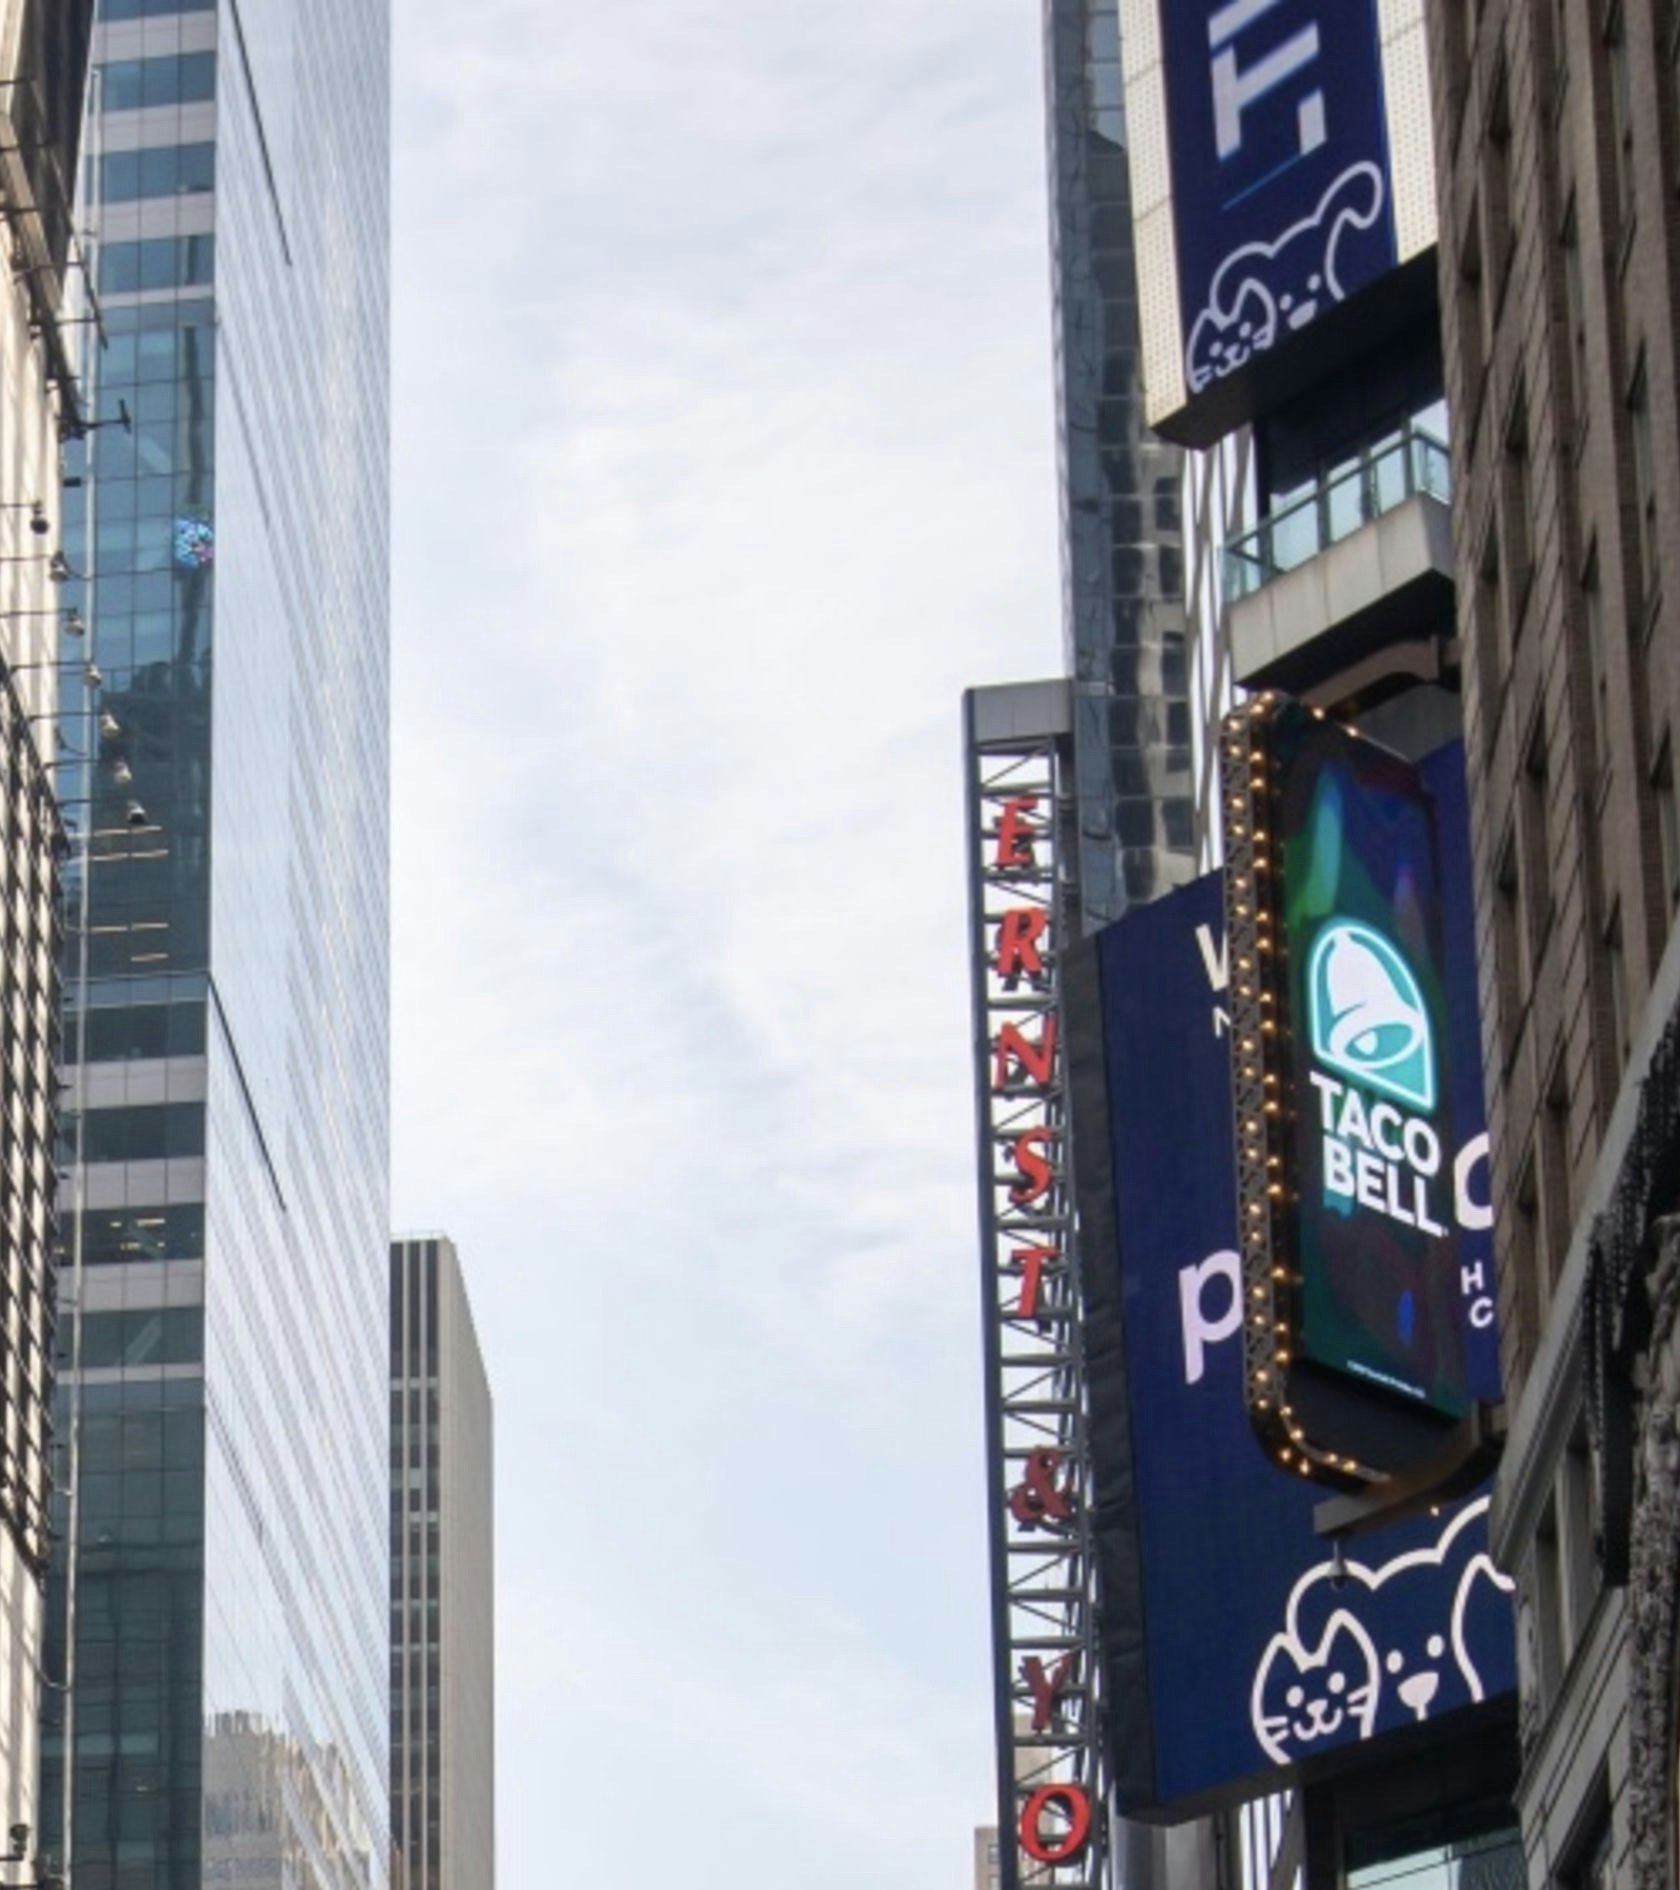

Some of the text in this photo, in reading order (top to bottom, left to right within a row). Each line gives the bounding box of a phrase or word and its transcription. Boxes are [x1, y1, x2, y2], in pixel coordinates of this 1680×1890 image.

[988, 793, 1063, 1323] ERNST
[1310, 1070, 1441, 1176] TACO
[1323, 1135, 1445, 1238] BELL
[1010, 1445, 1071, 1532] &
